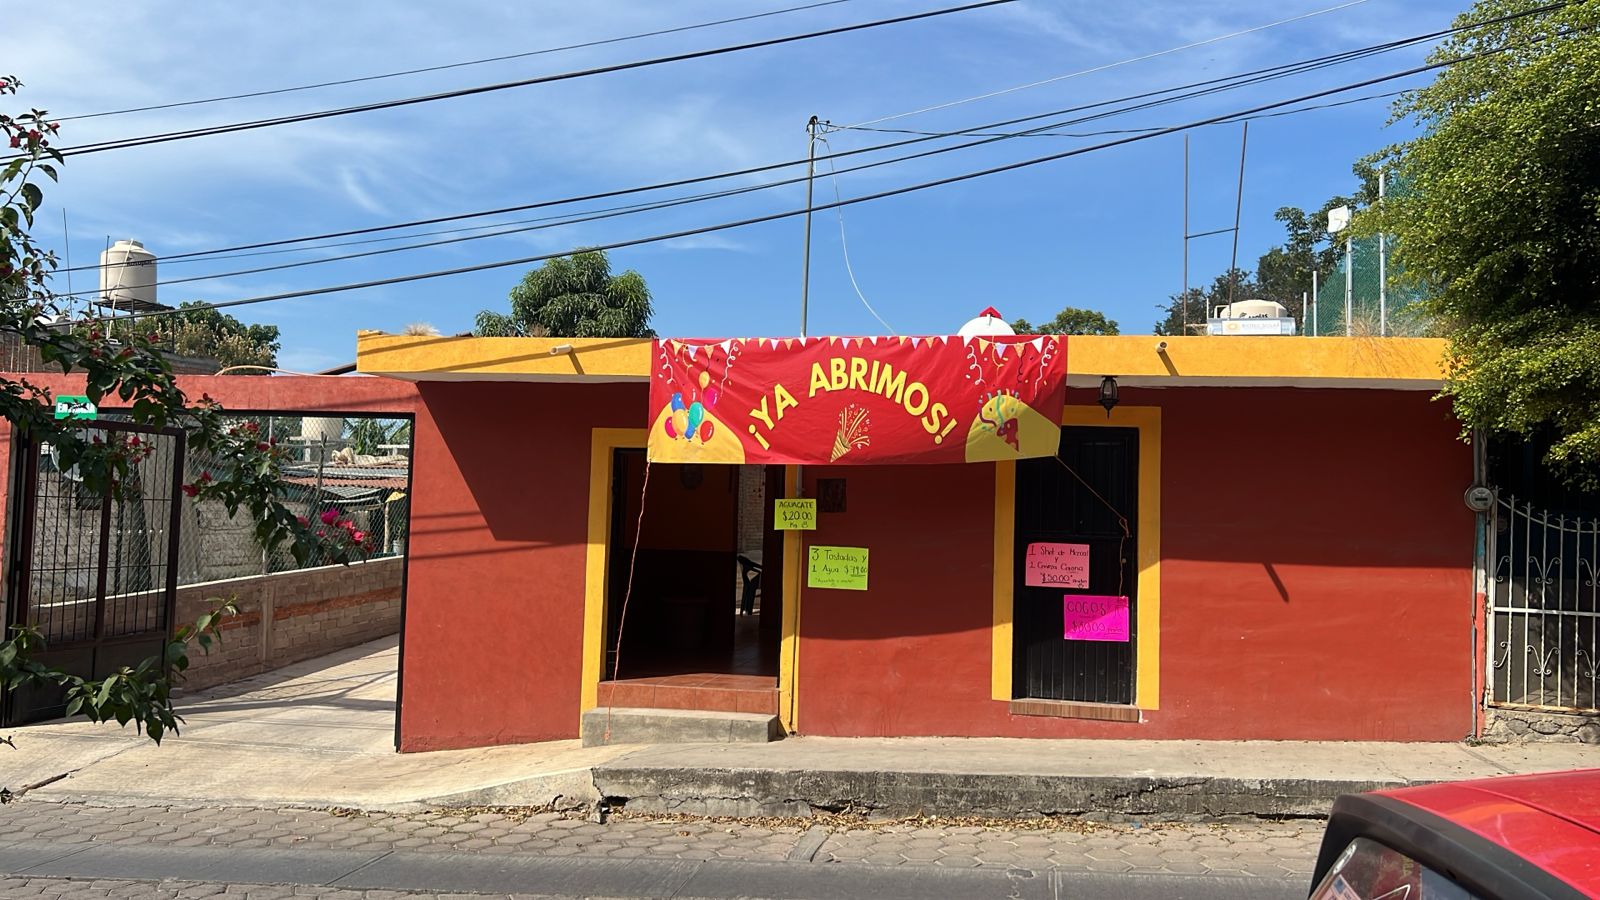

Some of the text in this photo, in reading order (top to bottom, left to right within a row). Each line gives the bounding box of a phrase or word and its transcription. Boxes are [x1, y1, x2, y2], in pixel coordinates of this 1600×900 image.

[748, 356, 958, 450] ¡YA ABRIMOS!
[783, 510, 812, 522] $20.00
[811, 547, 820, 561] 3
[824, 549, 857, 563] Tostadas
[822, 564, 839, 575] Agua
